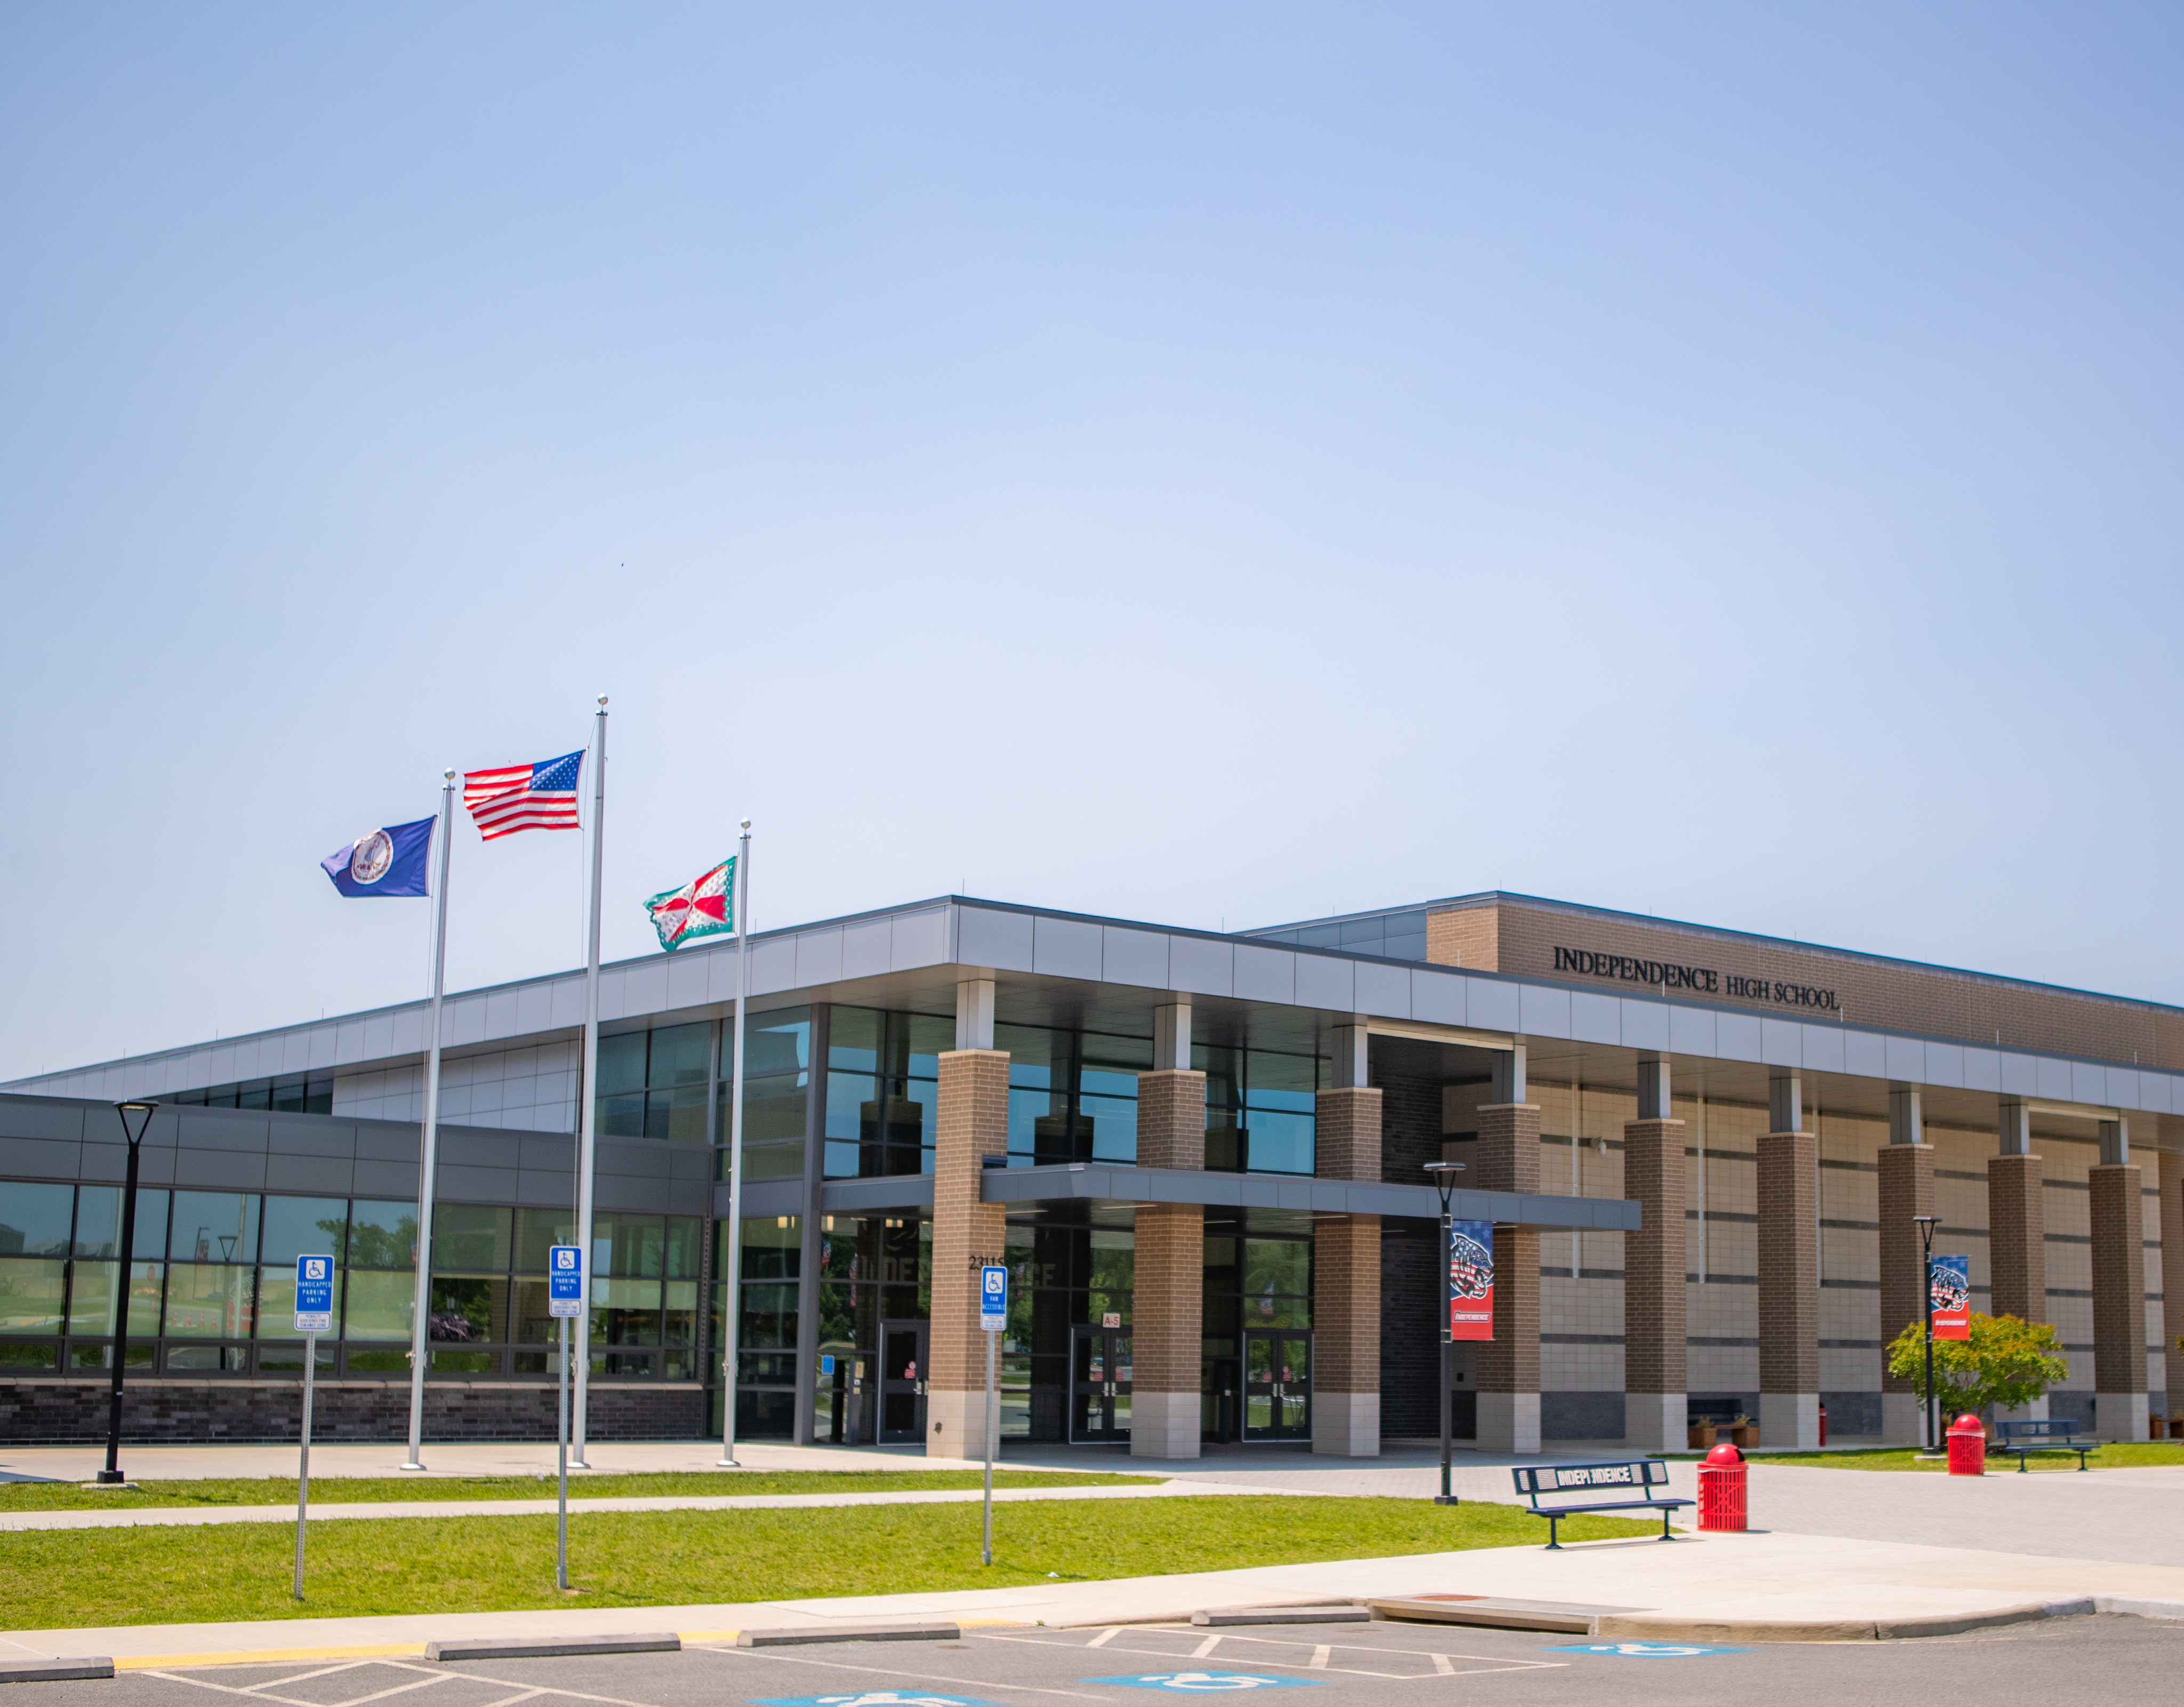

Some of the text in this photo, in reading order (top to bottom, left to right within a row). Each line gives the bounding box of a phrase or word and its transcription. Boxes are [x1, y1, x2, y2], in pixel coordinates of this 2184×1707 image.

[1554, 946, 1840, 1009] INDEPENDENCE HIGH SCHOOL
[1104, 1316, 1119, 1325] A-5
